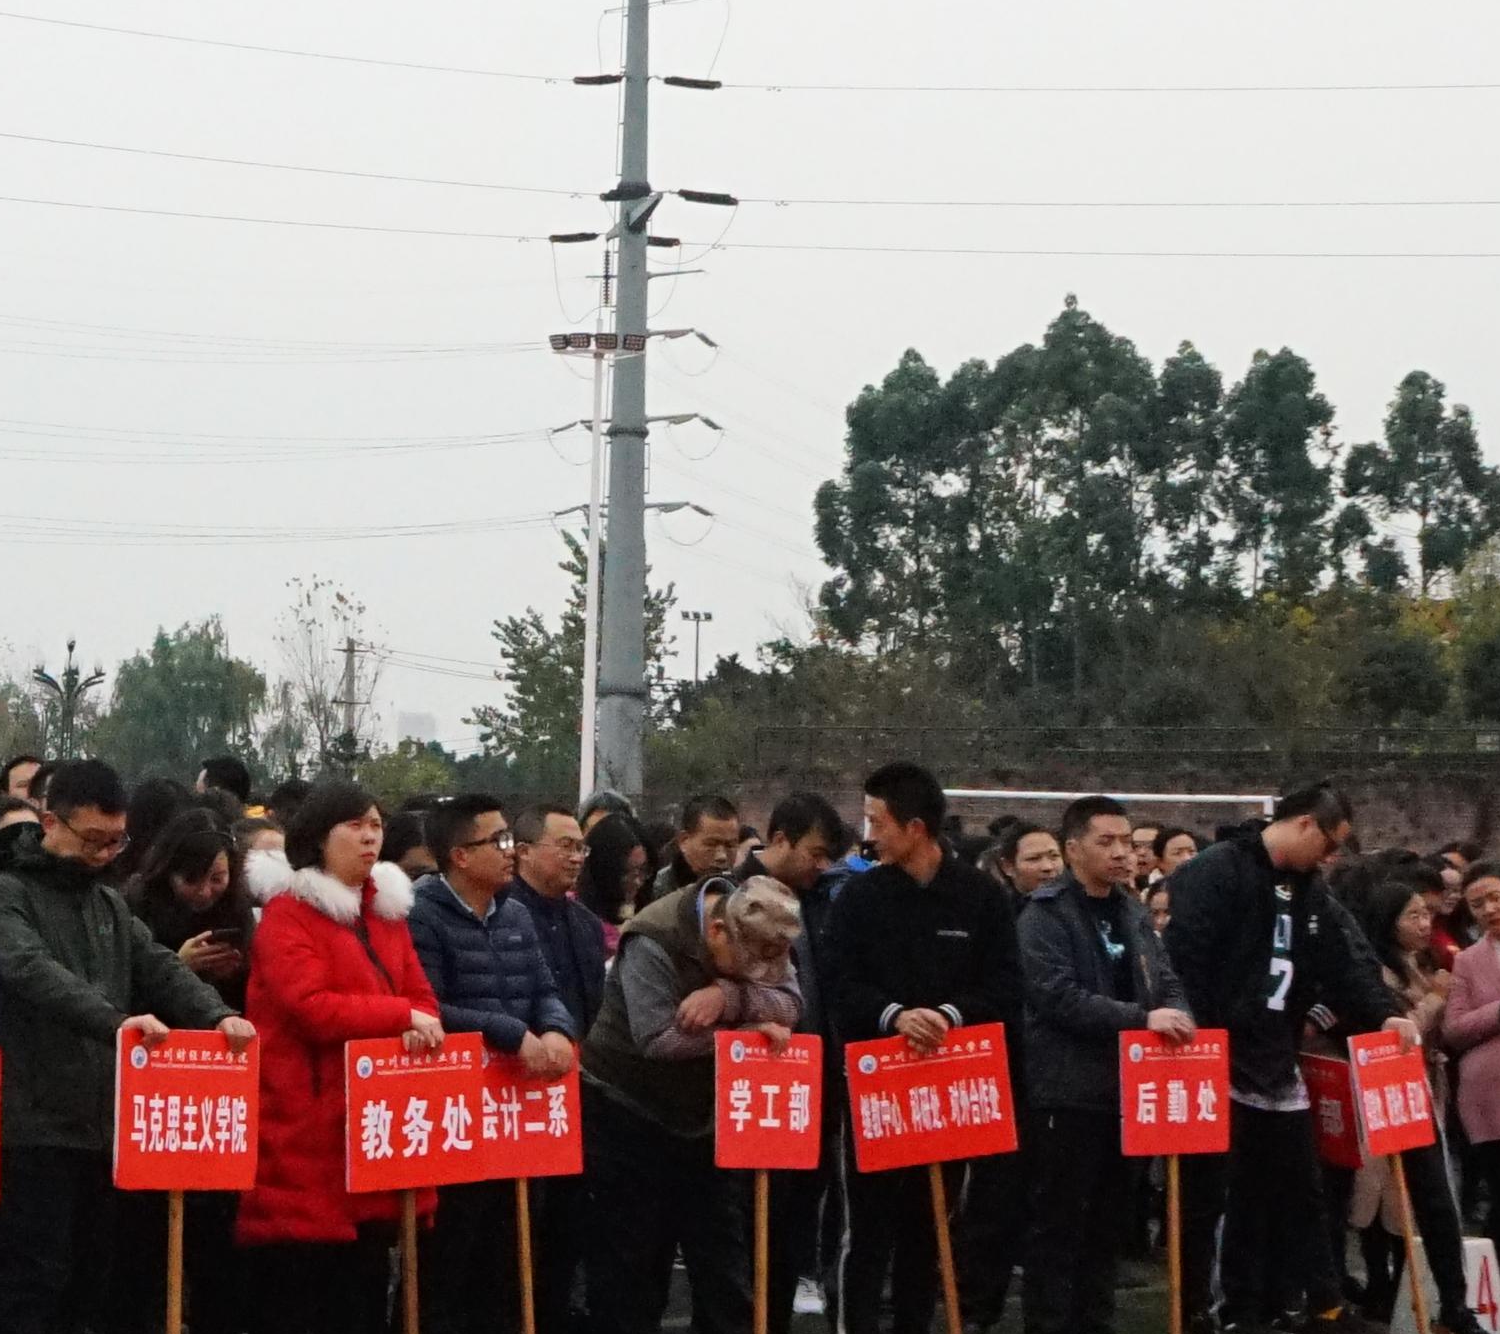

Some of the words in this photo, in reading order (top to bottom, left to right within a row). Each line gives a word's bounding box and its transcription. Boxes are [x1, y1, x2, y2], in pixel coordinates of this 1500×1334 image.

[130, 1092, 248, 1154] 马克思主义学院
[361, 1094, 473, 1160] 教务处
[482, 1084, 569, 1141] 会计二系
[729, 1078, 811, 1133] 学工部
[1136, 1079, 1218, 1124] 后勤处
